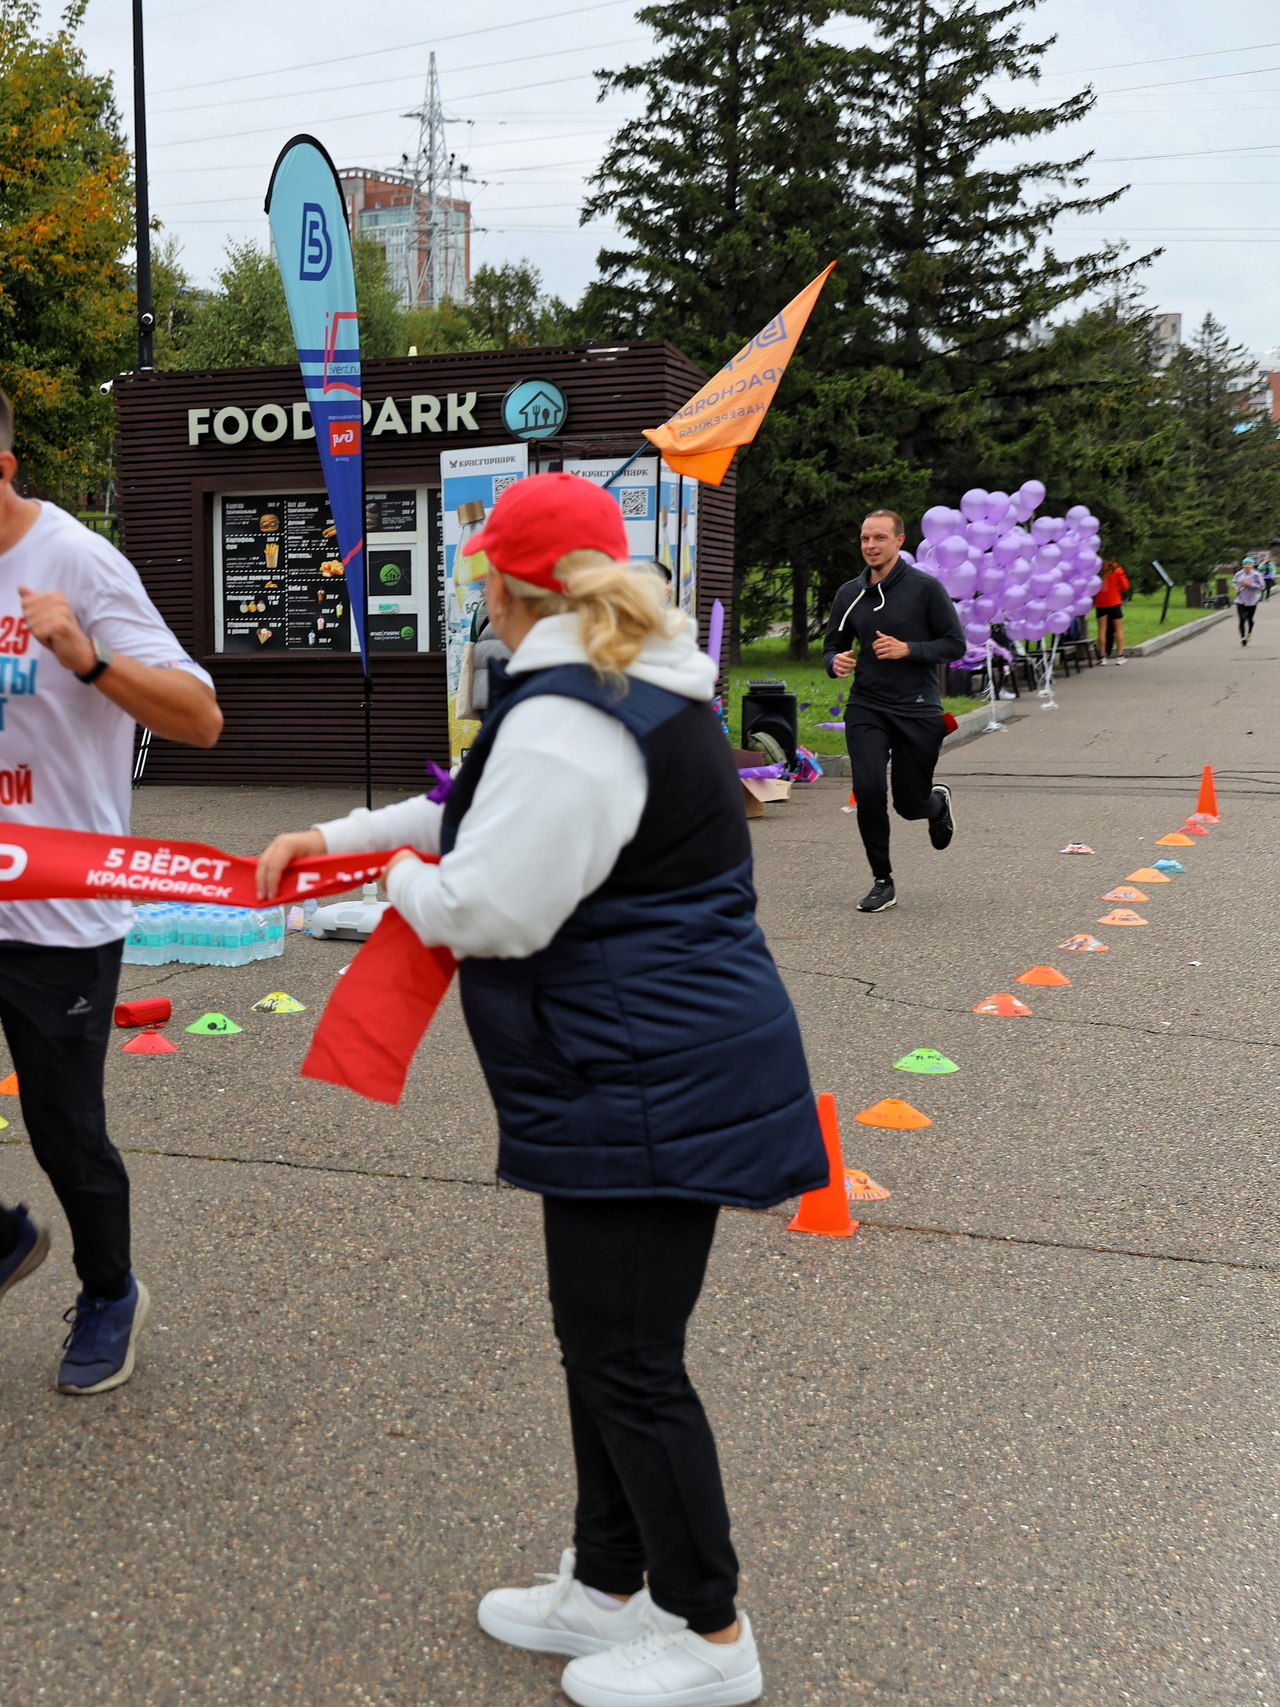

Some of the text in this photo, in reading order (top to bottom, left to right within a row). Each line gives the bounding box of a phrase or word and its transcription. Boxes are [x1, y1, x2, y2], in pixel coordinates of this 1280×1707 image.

[104, 847, 232, 881] 5 ВЁРСТ
[86, 870, 233, 899] КРАСНОЯРСК
